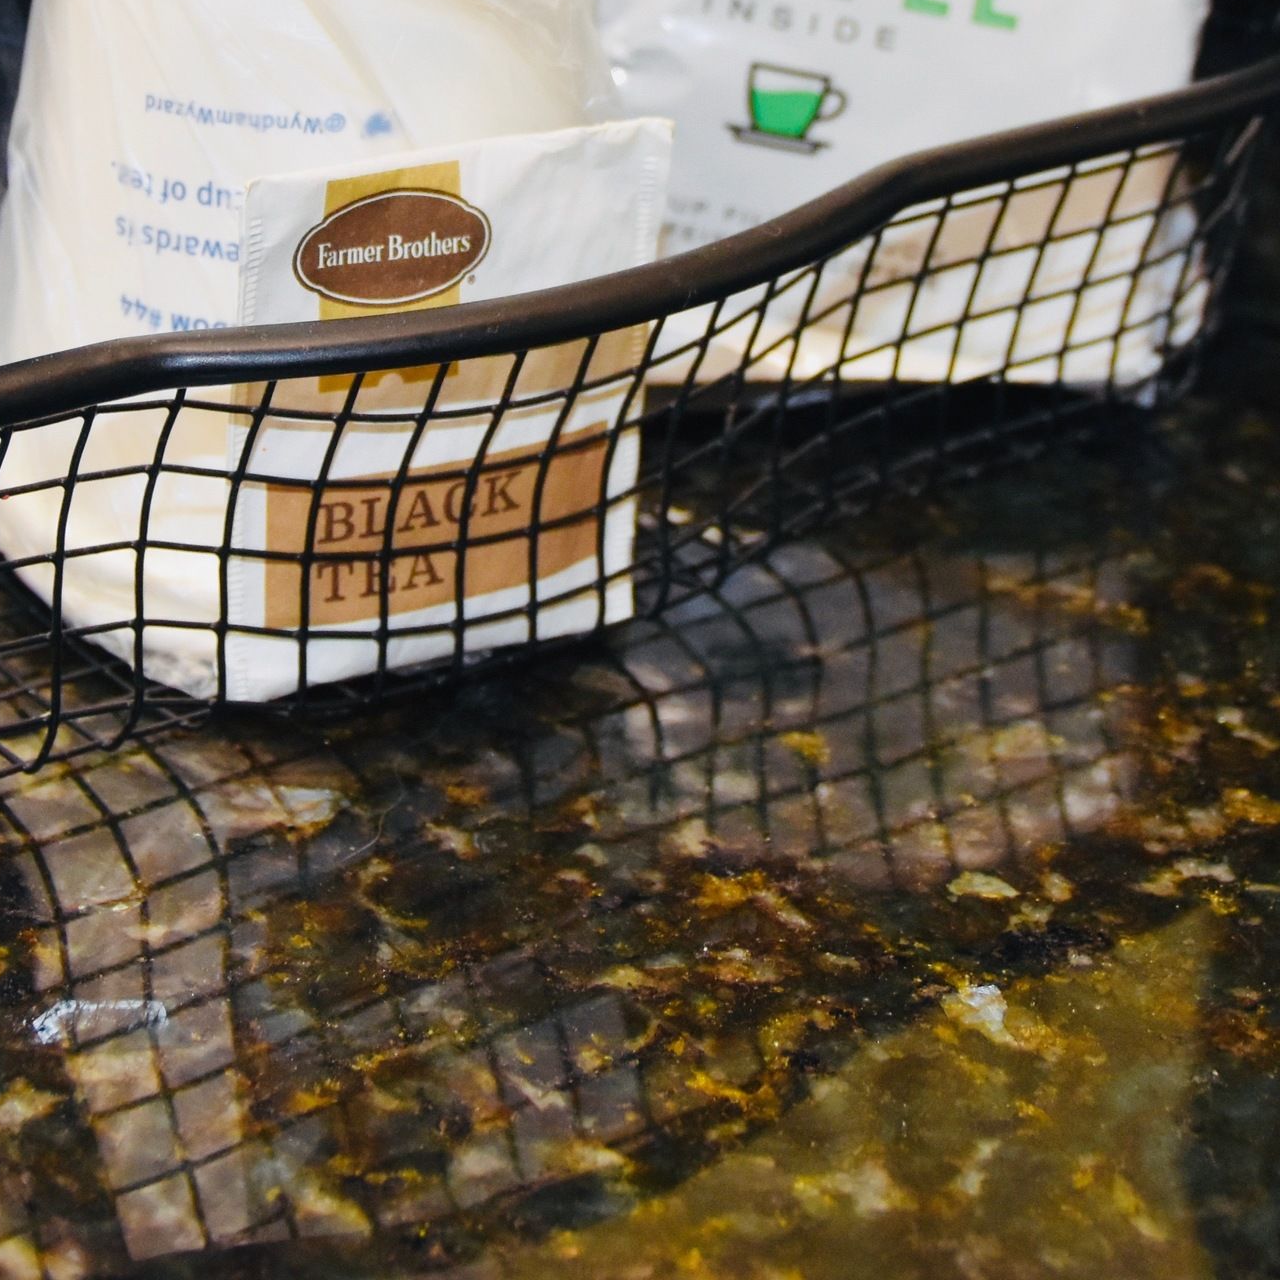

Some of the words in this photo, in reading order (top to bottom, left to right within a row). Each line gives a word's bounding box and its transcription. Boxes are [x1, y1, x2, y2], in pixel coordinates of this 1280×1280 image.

[162, 180, 187, 206] of
[116, 217, 134, 246] is
[317, 242, 384, 270] Farmer
[388, 231, 471, 261] Brothers
[317, 471, 522, 545] BLACK
[317, 550, 445, 603] TEA
